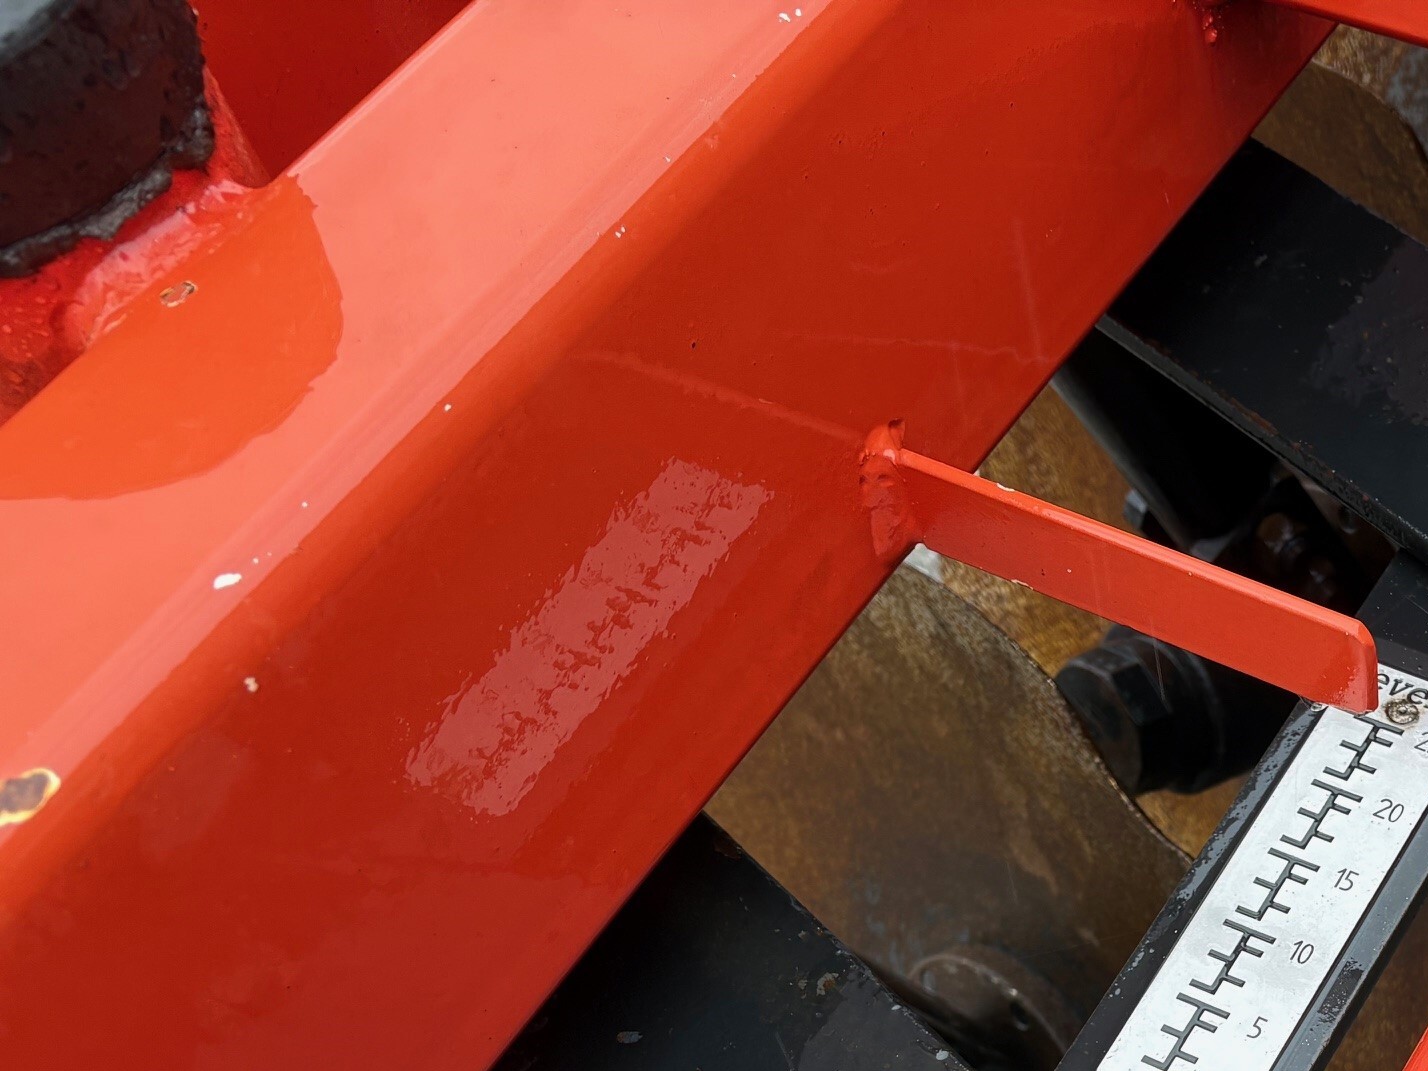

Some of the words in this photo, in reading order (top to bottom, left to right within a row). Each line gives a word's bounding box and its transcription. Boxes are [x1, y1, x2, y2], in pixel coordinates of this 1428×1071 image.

[1372, 798, 1405, 823] 20
[1333, 867, 1360, 891] 15
[1289, 940, 1315, 965] 10
[1246, 1016, 1269, 1039] 5
